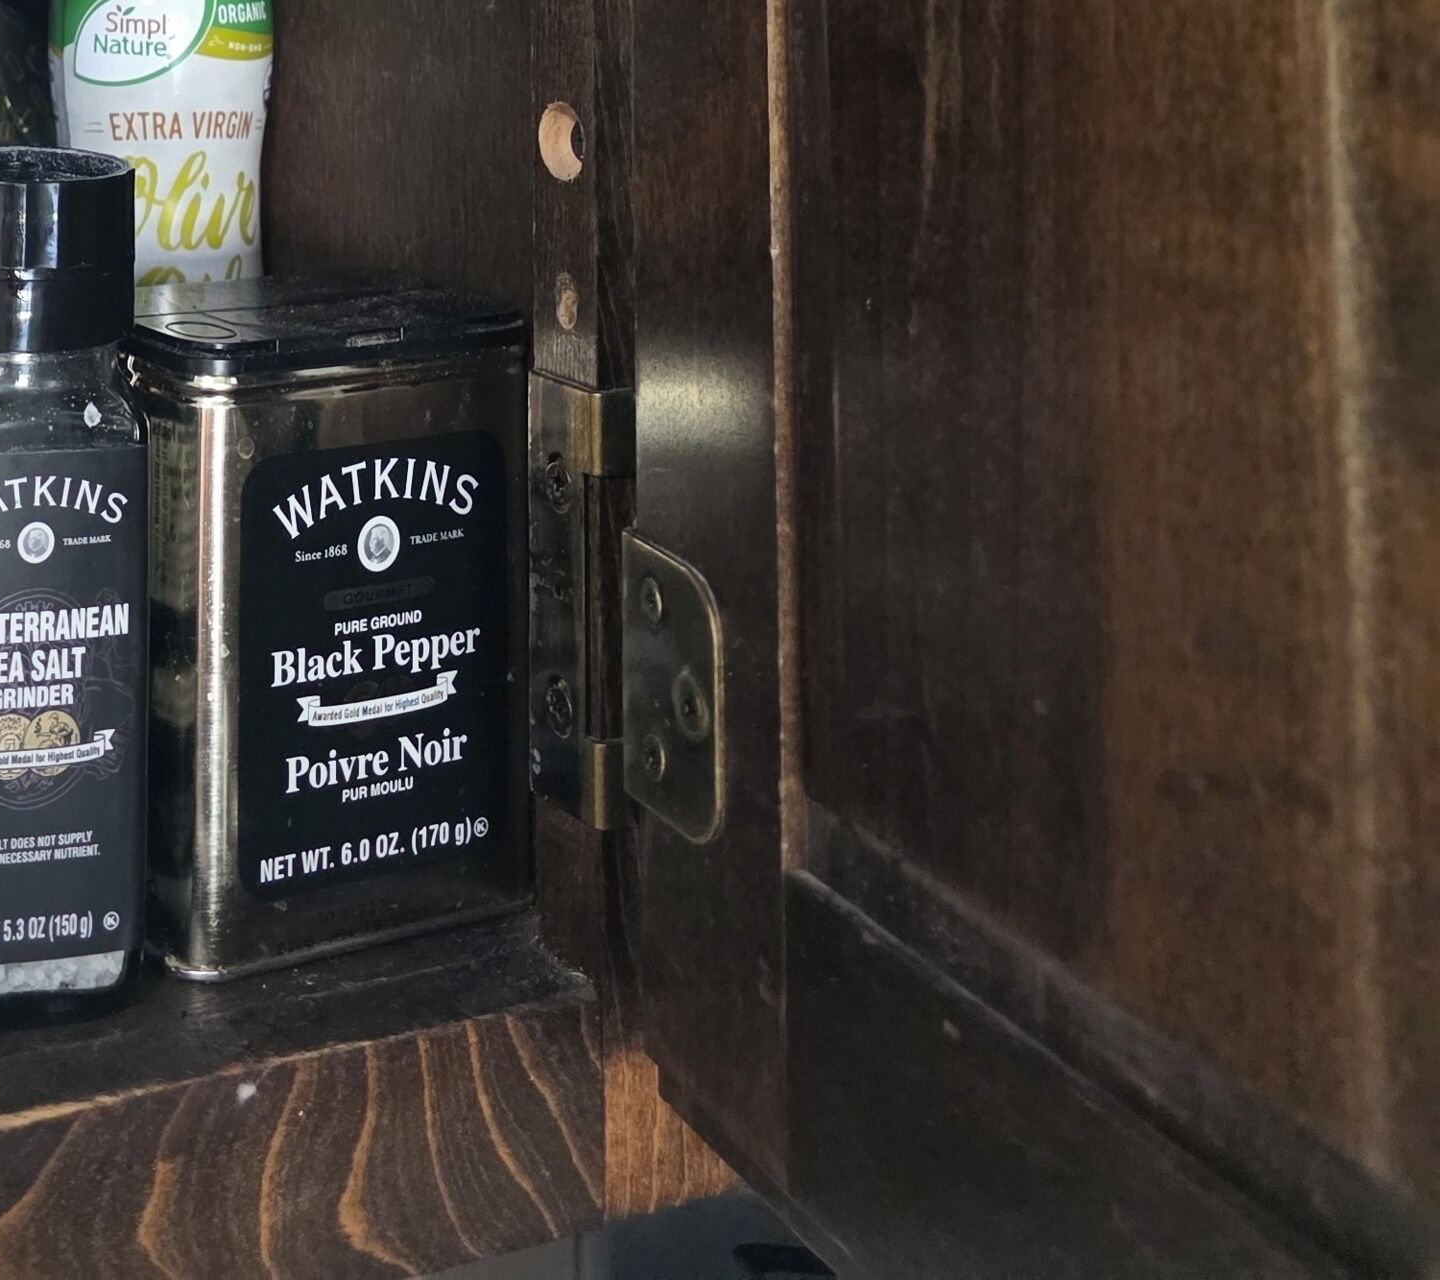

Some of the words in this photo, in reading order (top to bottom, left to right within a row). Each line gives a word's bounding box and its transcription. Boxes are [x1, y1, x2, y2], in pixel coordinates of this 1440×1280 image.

[105, 10, 170, 40] Simpl
[218, 0, 266, 24] ORGANIC
[94, 34, 167, 57] Nature
[108, 112, 182, 142] EXTRA
[192, 110, 253, 140] VIRGIN
[272, 457, 480, 540] WATKINS
[62, 536, 88, 545] TRADE
[89, 534, 112, 543] MARK
[294, 550, 322, 562] Since
[324, 544, 348, 559] 1868
[410, 533, 438, 546] TRADE
[440, 528, 465, 540] MARK
[334, 618, 368, 636] PURE
[370, 609, 422, 630] GROUND
[30, 646, 86, 682] SALT
[270, 639, 364, 688] Black
[372, 627, 481, 674] Pepper
[312, 710, 342, 721] Awarded
[344, 707, 360, 719] Gold
[362, 703, 382, 716] Medal
[384, 702, 394, 712] for
[395, 696, 420, 711] Highest
[422, 690, 444, 704] Quality
[10, 753, 34, 764] Medal
[35, 752, 46, 762] for
[47, 750, 74, 764] Highest
[76, 745, 101, 758] Quality
[285, 748, 389, 794] Poivre
[397, 728, 468, 772] Noir
[342, 783, 368, 803] PUR
[370, 776, 414, 797] MOULU
[10, 836, 35, 848] DOES
[36, 834, 56, 847] NOT
[58, 830, 93, 846] SUPPLY
[54, 844, 101, 860] NUTRIENT.
[260, 853, 297, 884] NET
[300, 846, 335, 874] WT.
[341, 838, 370, 866] 6.0
[376, 832, 405, 858] OZ.
[411, 821, 449, 856] (170
[454, 816, 472, 846] g)
[3, 918, 24, 941] 5.3
[28, 916, 46, 940] OZ
[49, 912, 78, 942] (150
[80, 910, 93, 938] g)
